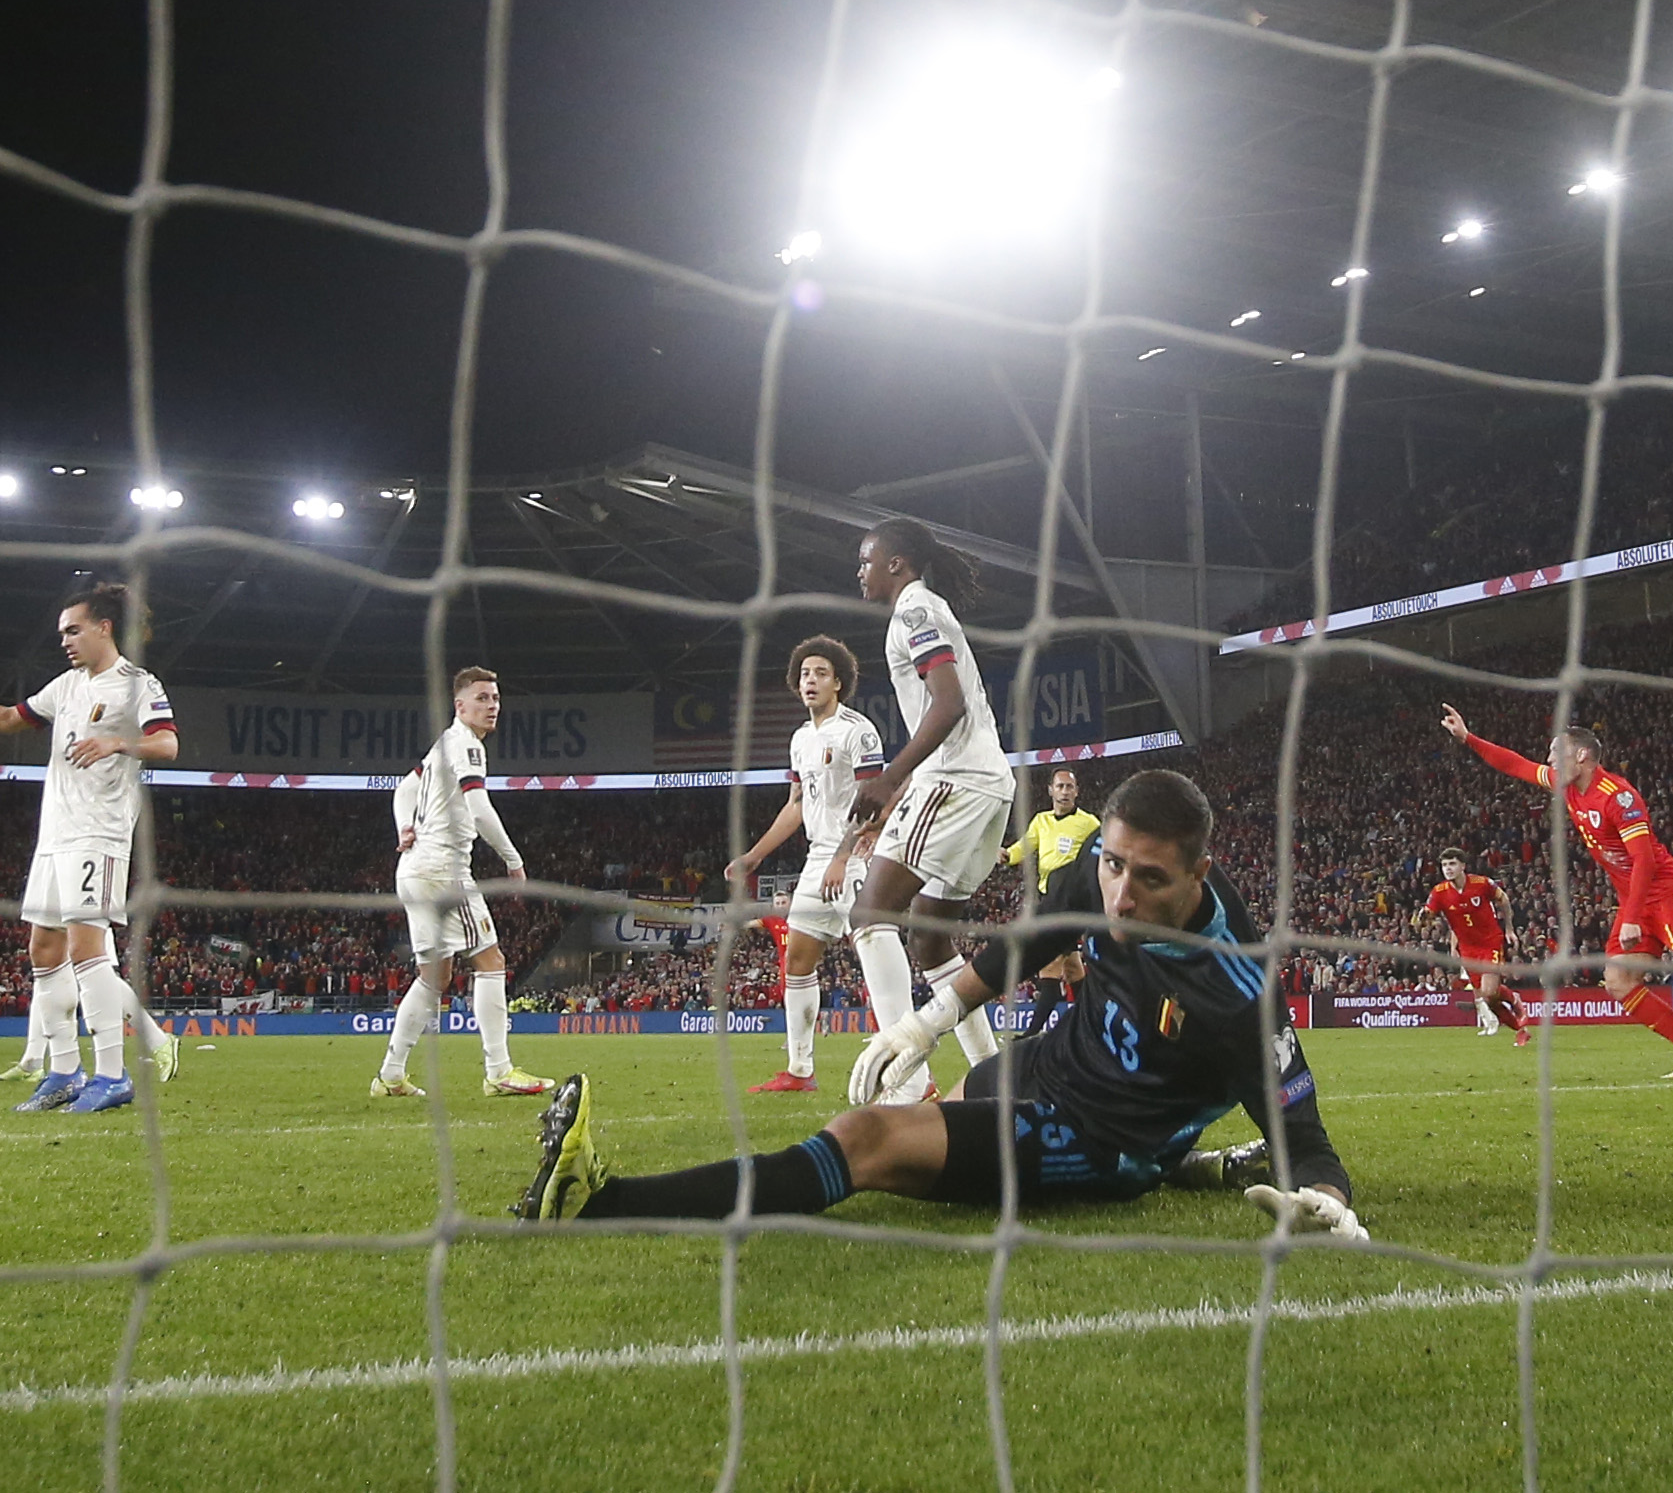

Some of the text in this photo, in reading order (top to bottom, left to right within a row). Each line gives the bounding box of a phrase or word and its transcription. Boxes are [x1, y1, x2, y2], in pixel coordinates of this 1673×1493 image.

[1371, 593, 1439, 622] ABSOLUTETOUCH
[229, 705, 588, 761] VISIT PHILINES
[654, 772, 734, 787] ABSOLUTETOUCH
[81, 860, 96, 892] 2
[449, 1012, 513, 1031] Dos
[727, 1011, 764, 1031] Doors
[994, 1005, 1060, 1031] Garae
[1362, 1010, 1419, 1029] Qualifiers
[1102, 999, 1140, 1072] 13
